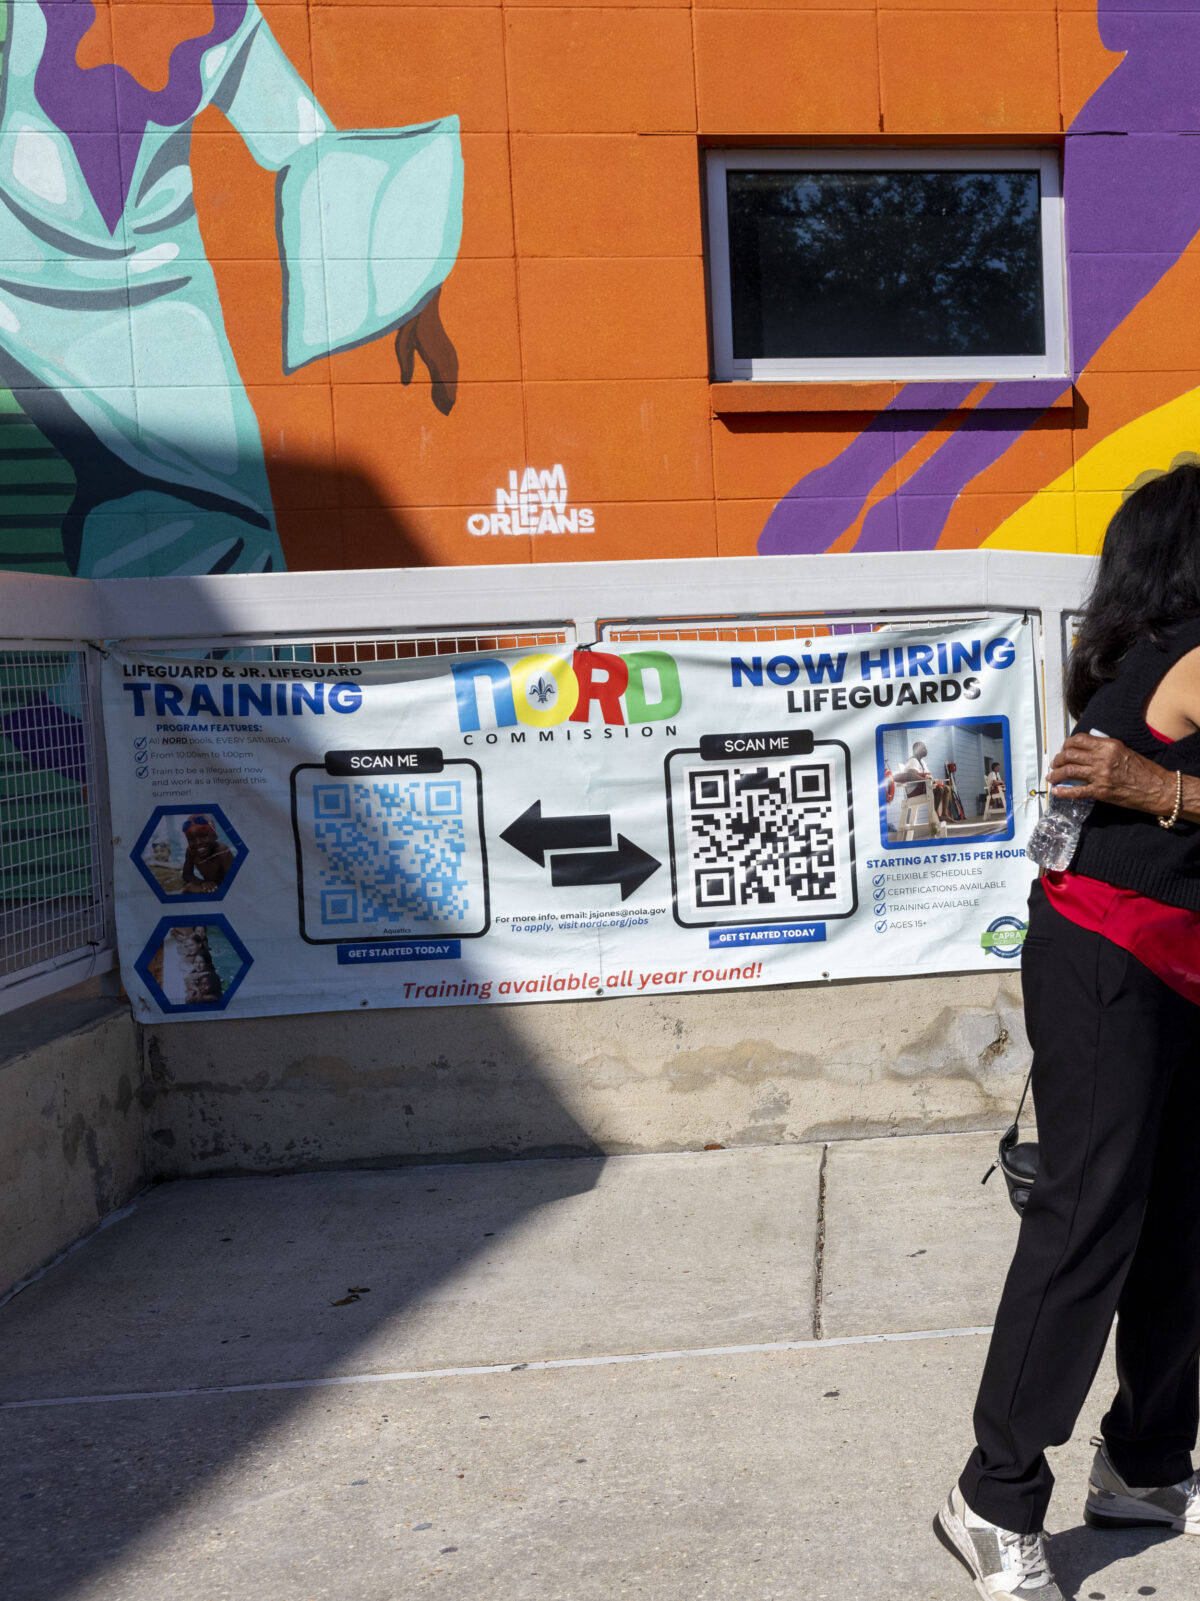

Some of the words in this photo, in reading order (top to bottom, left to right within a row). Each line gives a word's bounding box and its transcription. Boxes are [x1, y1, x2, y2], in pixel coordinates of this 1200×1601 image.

[509, 470, 518, 490] I
[519, 463, 568, 493] AM
[496, 488, 568, 517] NEW
[467, 508, 595, 536] ORLEANS
[731, 652, 848, 687] NOW
[861, 637, 1016, 681] HIRING
[123, 664, 218, 679] LIFEGUARD
[222, 667, 235, 678] &
[239, 668, 265, 678] JR.
[269, 666, 363, 679] LIFEGUARD
[123, 682, 363, 717] TRAINING
[788, 677, 981, 713] LIFEGUARDS
[156, 724, 209, 732] PROGRAM
[210, 724, 263, 732] FEATURES:
[463, 725, 677, 745] COMMISSION
[149, 737, 160, 745] All
[162, 737, 188, 745] NORD
[247, 736, 292, 744] SATURDAY
[724, 738, 766, 752] SCAN
[769, 737, 789, 750] ME
[222, 751, 254, 761] 1:00pm
[350, 755, 393, 769] SCAN
[396, 754, 418, 767] ME
[205, 766, 242, 776] lifeguard
[152, 778, 168, 786] and
[170, 778, 192, 786] work
[213, 777, 249, 786] lifeguard
[152, 790, 192, 798] summer!
[866, 856, 921, 869] STARTING
[923, 854, 938, 864] AT
[940, 852, 970, 864] $17.15
[974, 851, 994, 860] PER
[995, 848, 1026, 859] HOUR
[886, 872, 928, 882] FLEIXIBLE
[930, 868, 982, 878] SCHEDULES
[887, 885, 958, 896] CERTIFICATIONS
[959, 881, 1006, 891] AVAILABLE
[888, 902, 930, 912] TRAINING
[932, 899, 979, 909] AVAILABLE
[538, 913, 558, 922] info,
[560, 911, 588, 920] email:
[588, 908, 667, 920] jsjones@nola.gov
[511, 924, 522, 932] To
[524, 922, 554, 934] apply,
[558, 921, 578, 930] visit
[580, 917, 649, 929] nordc.org/jobs
[889, 920, 913, 929] AGES
[719, 933, 735, 942] GET
[738, 930, 780, 941] STARTED
[782, 928, 816, 938] TODAY
[992, 932, 1022, 941] CAPRA
[348, 949, 367, 958] GET
[369, 947, 413, 957] STARTED
[415, 946, 450, 955] TODAY
[403, 979, 493, 999] Training
[498, 972, 600, 995] available
[606, 969, 634, 988] all
[637, 968, 688, 991] year
[692, 962, 762, 982] round!
